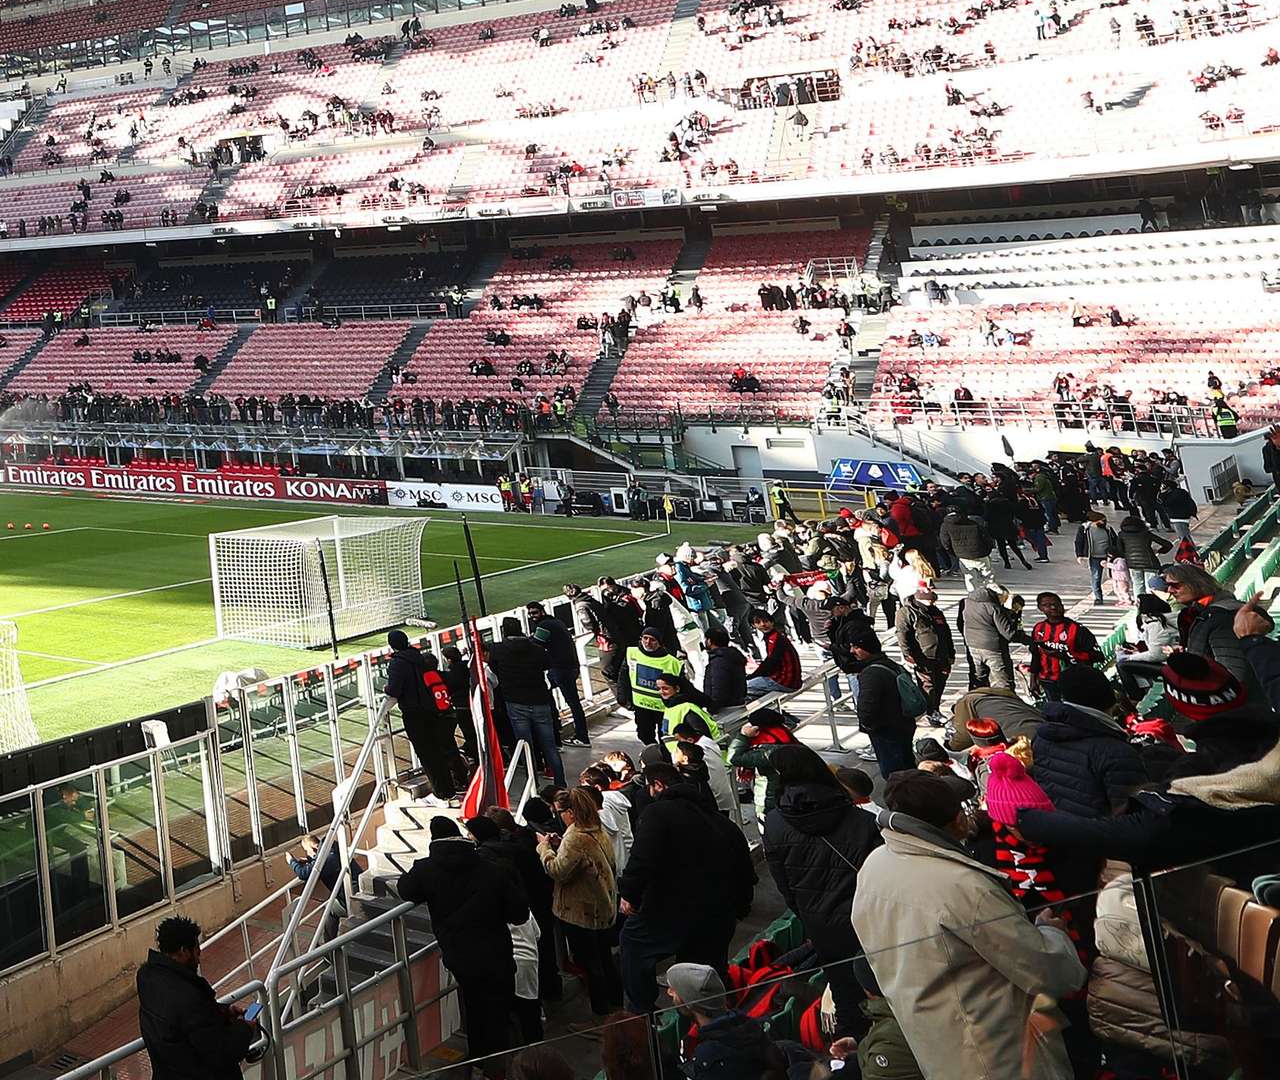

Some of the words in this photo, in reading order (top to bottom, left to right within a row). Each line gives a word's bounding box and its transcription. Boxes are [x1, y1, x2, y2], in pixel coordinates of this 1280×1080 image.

[8, 466, 85, 486] Emirates
[91, 469, 176, 491] Emirates
[181, 474, 275, 497] Emirates
[409, 489, 441, 501] MSC
[467, 492, 501, 504] MSC
